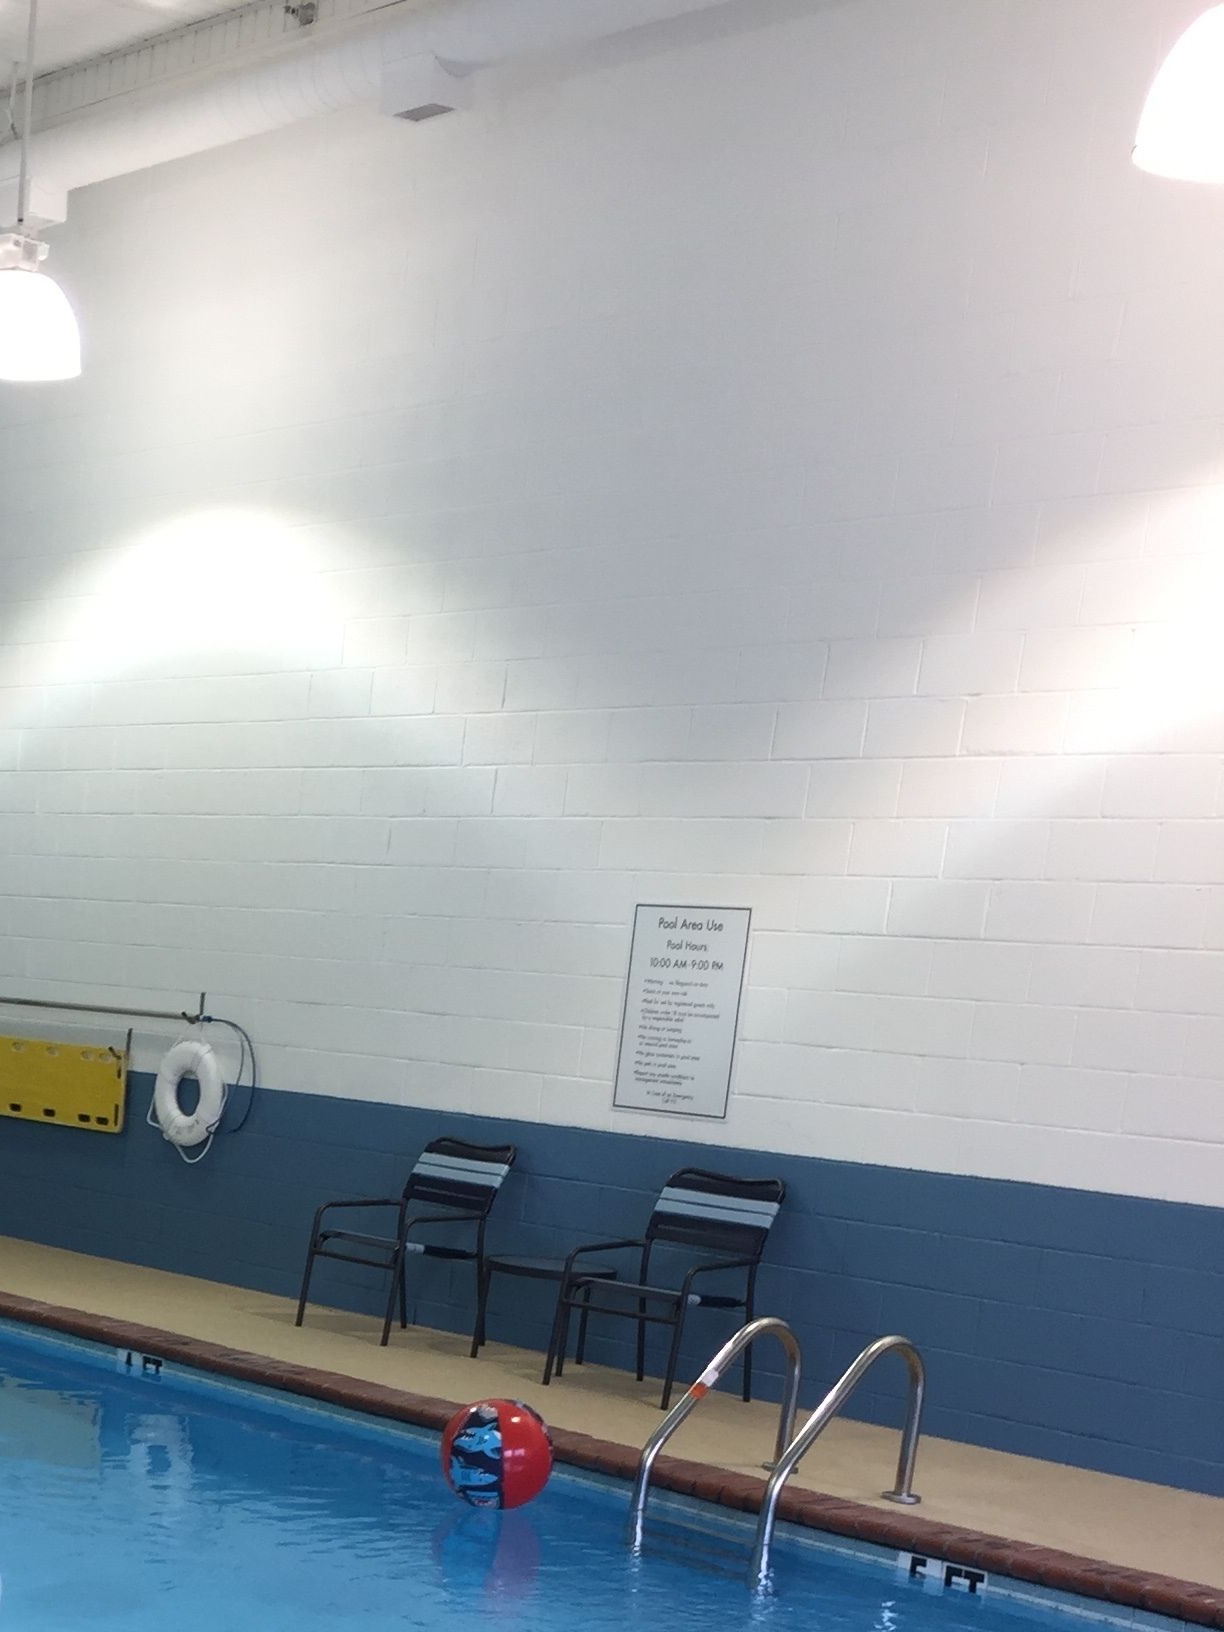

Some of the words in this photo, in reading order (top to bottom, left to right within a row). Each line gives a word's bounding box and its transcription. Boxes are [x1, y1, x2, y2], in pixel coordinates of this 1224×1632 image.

[658, 916, 678, 930] Pool
[680, 919, 703, 931] Area
[706, 919, 724, 931] Use
[666, 939, 683, 950] Pool
[685, 941, 707, 952] Hours
[711, 960, 724, 970] PM
